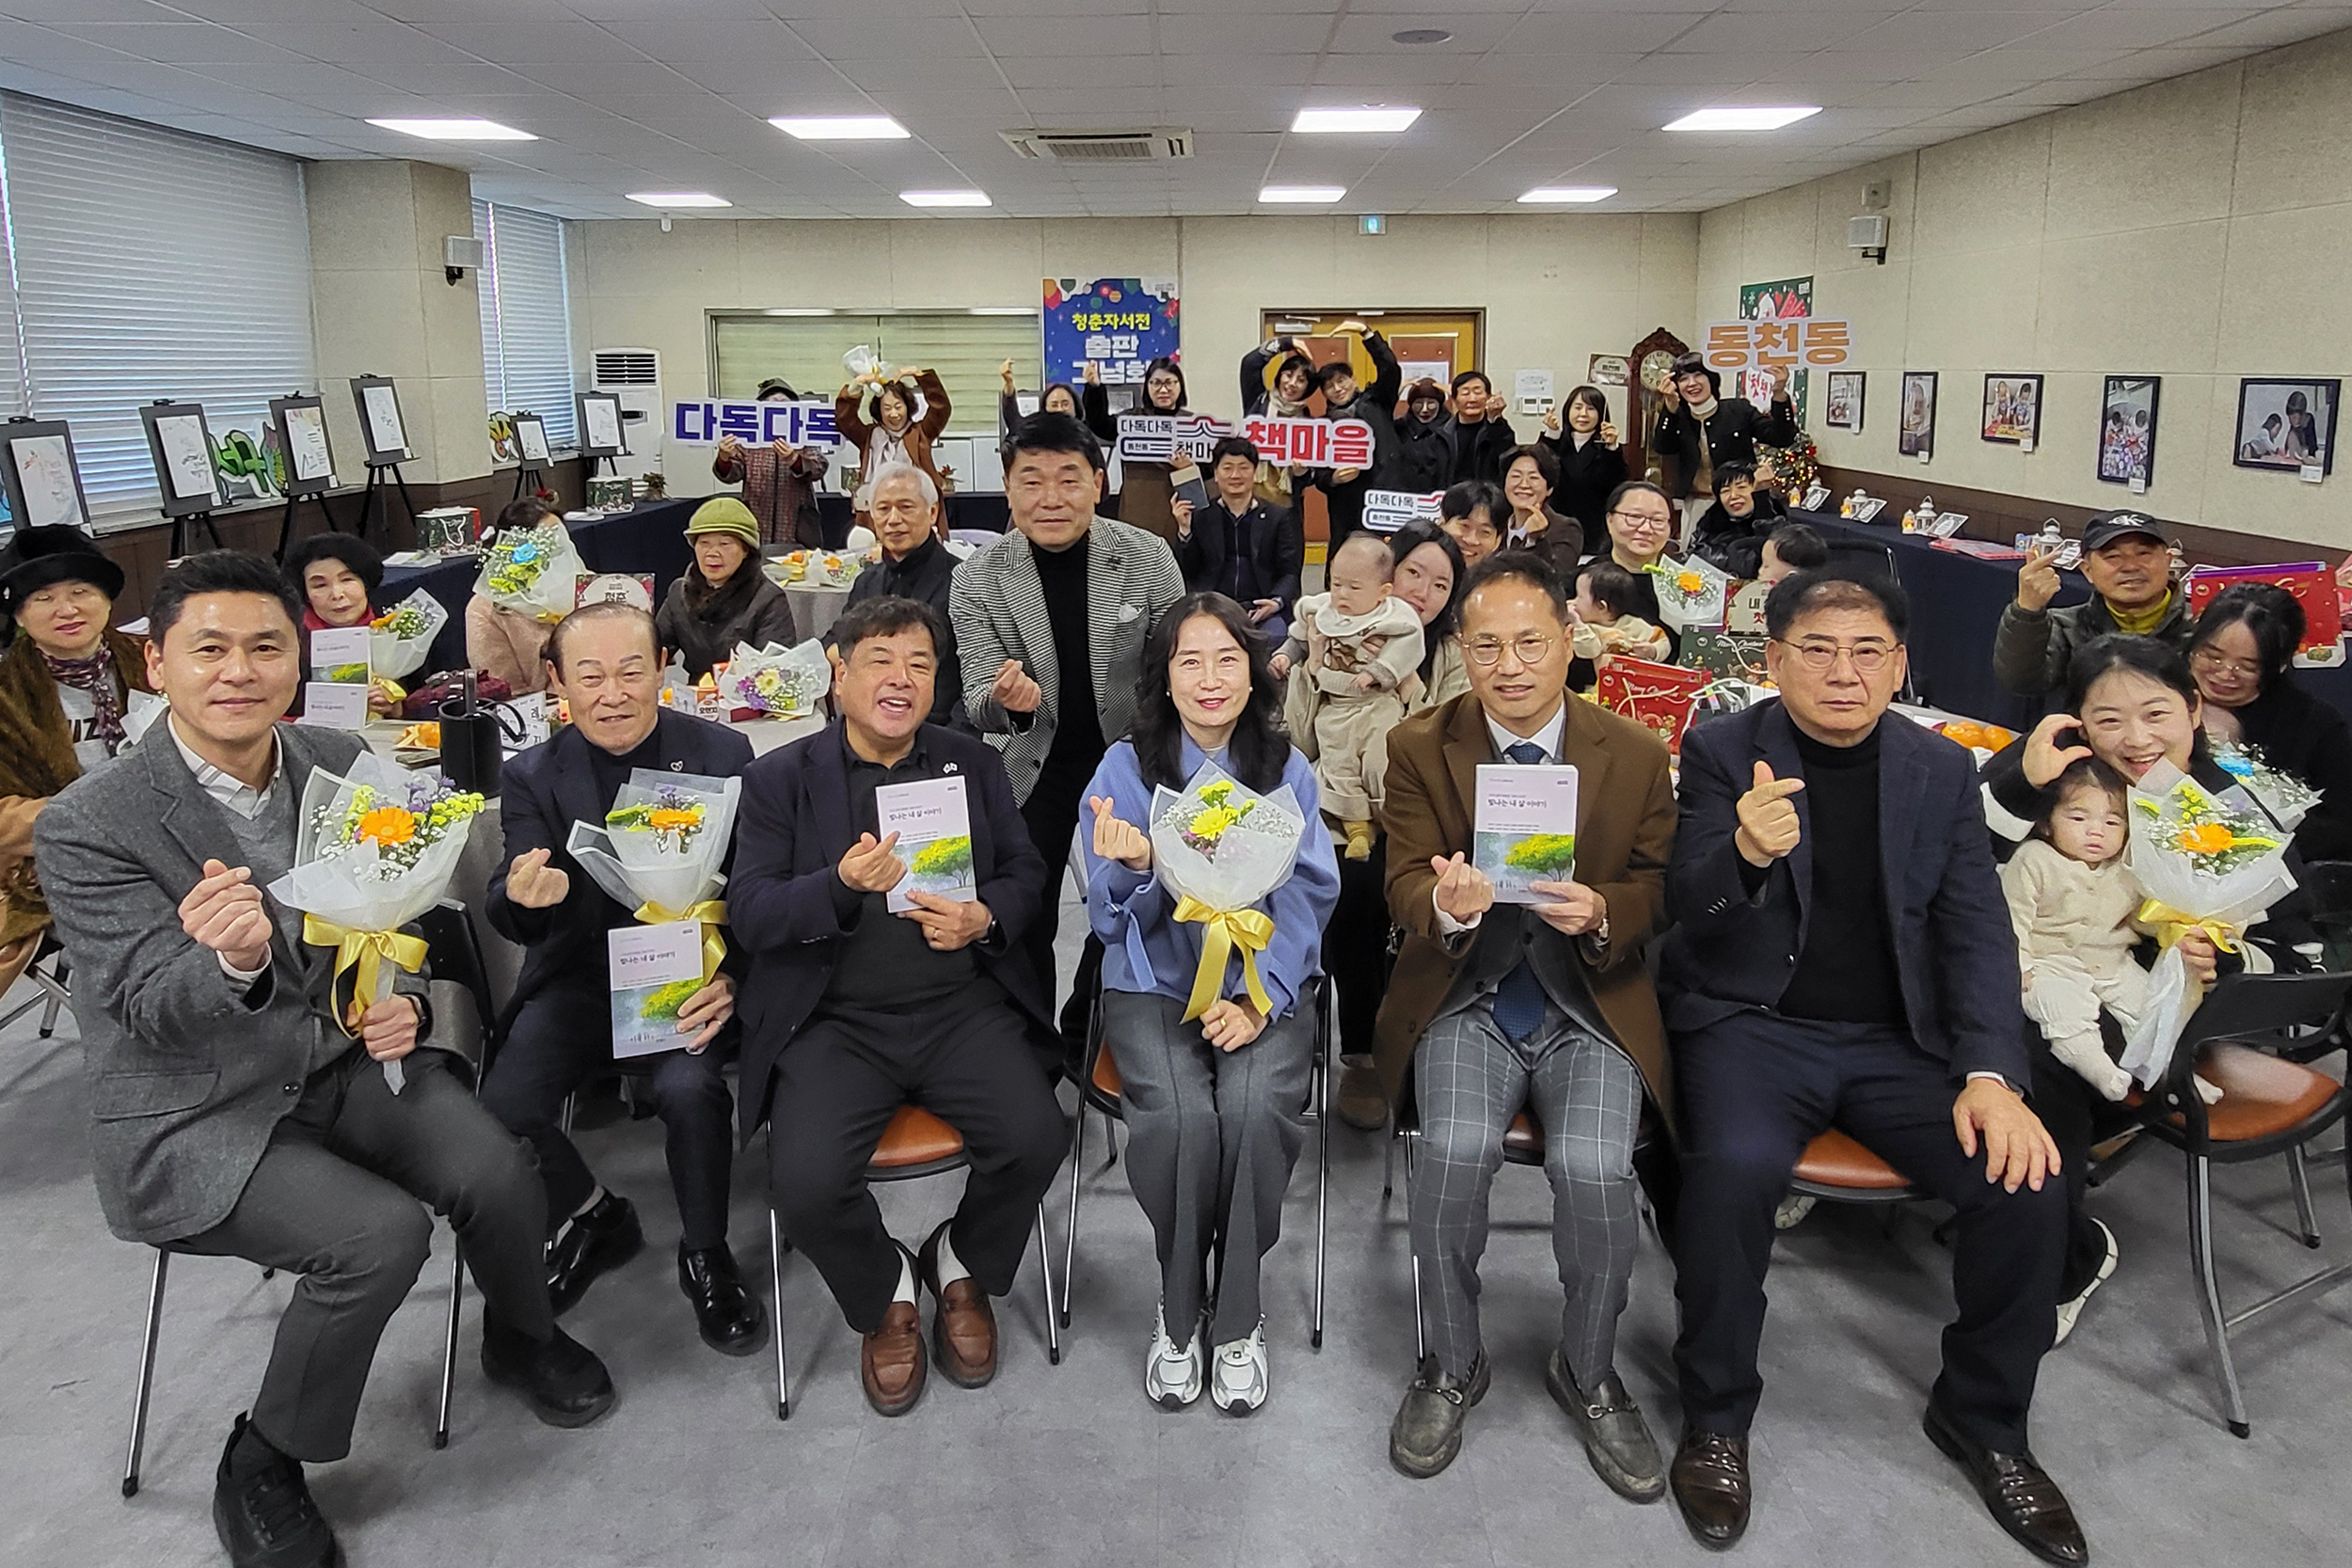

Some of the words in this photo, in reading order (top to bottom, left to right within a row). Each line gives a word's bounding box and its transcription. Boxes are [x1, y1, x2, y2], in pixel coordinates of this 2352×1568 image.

[1072, 312, 1152, 331] 청춘자서전
[1086, 335, 1139, 358] 출판
[1708, 322, 1850, 367] 동천동
[675, 403, 841, 446] 다독다독
[1120, 420, 1173, 434] 다독다독
[1176, 441, 1214, 459] 책마
[1246, 420, 1370, 464] 책마을
[1368, 493, 1414, 508] 다독다독
